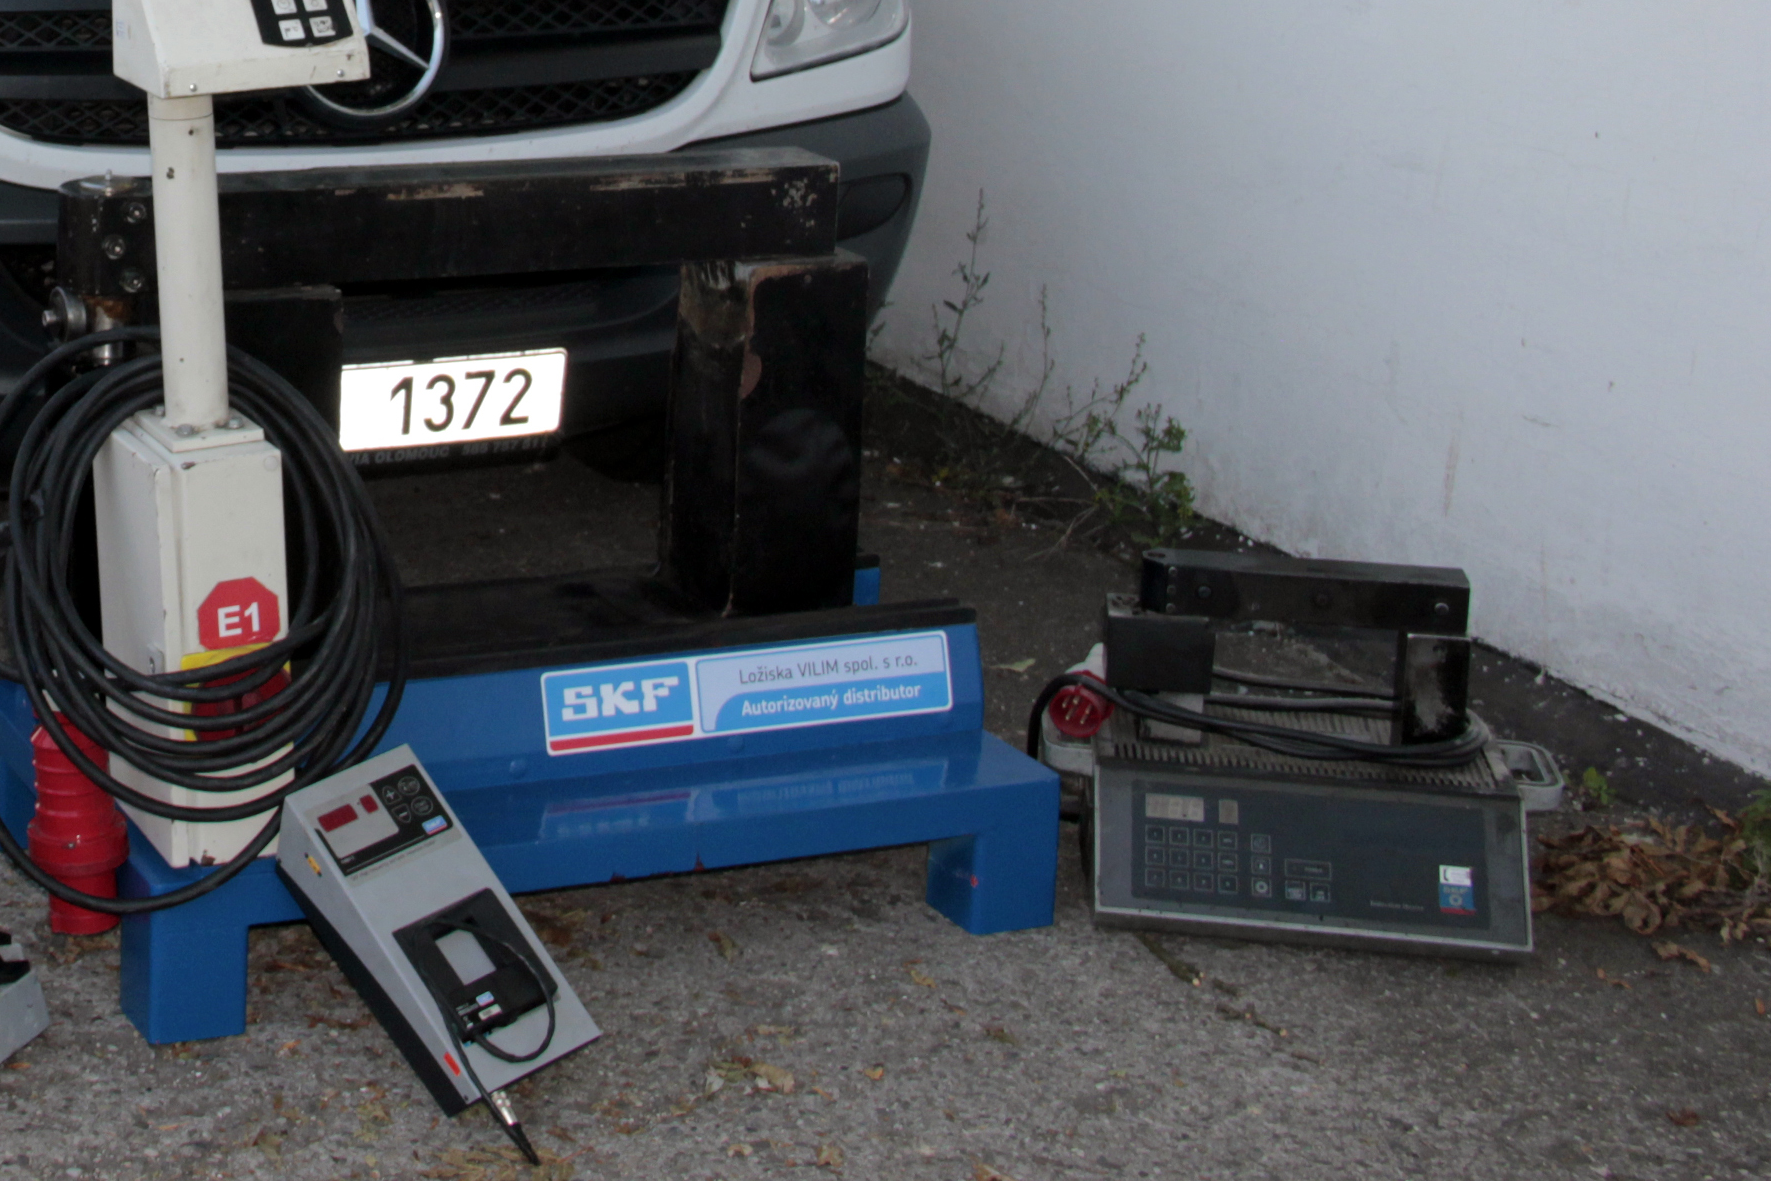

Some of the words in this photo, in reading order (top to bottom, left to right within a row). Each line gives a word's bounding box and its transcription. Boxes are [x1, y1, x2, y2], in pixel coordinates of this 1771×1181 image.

[390, 368, 533, 435] 1372
[374, 445, 451, 464] OLOMOUC
[216, 601, 260, 638] E1
[738, 665, 794, 685] Ložiska
[797, 658, 839, 678] VILIM
[843, 655, 878, 676] spol.
[883, 656, 891, 669] s
[895, 654, 918, 668] r.o.
[561, 675, 679, 722] SKF
[741, 689, 839, 717] Autorizovaný
[843, 684, 922, 705] distributor
